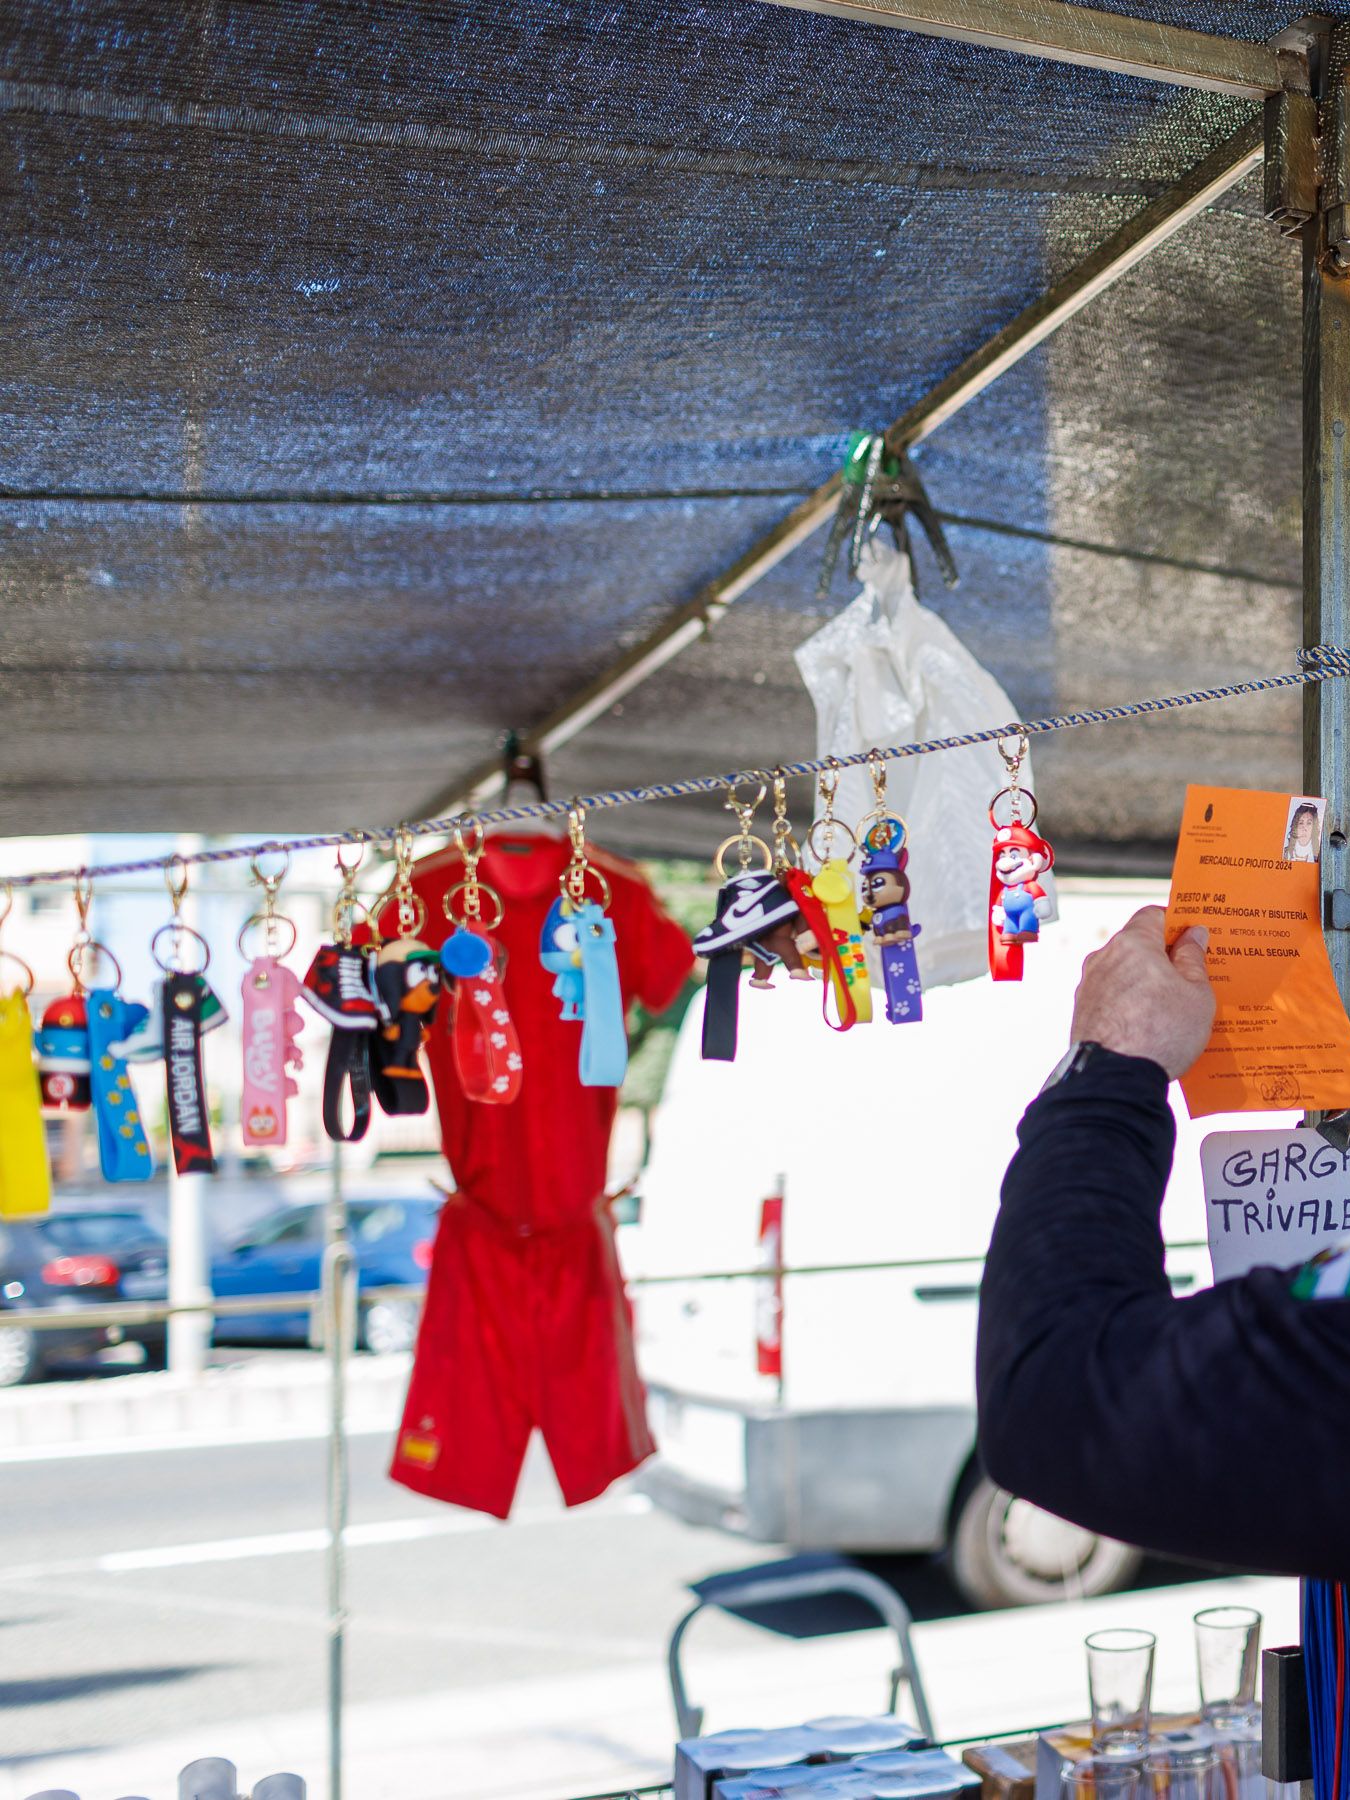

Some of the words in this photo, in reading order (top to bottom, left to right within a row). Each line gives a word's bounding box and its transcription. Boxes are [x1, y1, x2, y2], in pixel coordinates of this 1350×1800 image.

[1199, 856, 1244, 867] MERCADILLO
[1245, 858, 1274, 869] PIOJITO
[1275, 861, 1293, 870] 2024
[1176, 893, 1201, 902] PUESTO
[1213, 894, 1226, 903] 048
[1203, 906, 1260, 917] MENAJE/HOGAR
[1262, 909, 1267, 918] Y
[1216, 946, 1242, 955] SILVIA
[1244, 948, 1264, 956] LEAL
[1266, 949, 1300, 957] SEGURA
[171, 1018, 195, 1050] AIR
[171, 1054, 202, 1133] JORDAN
